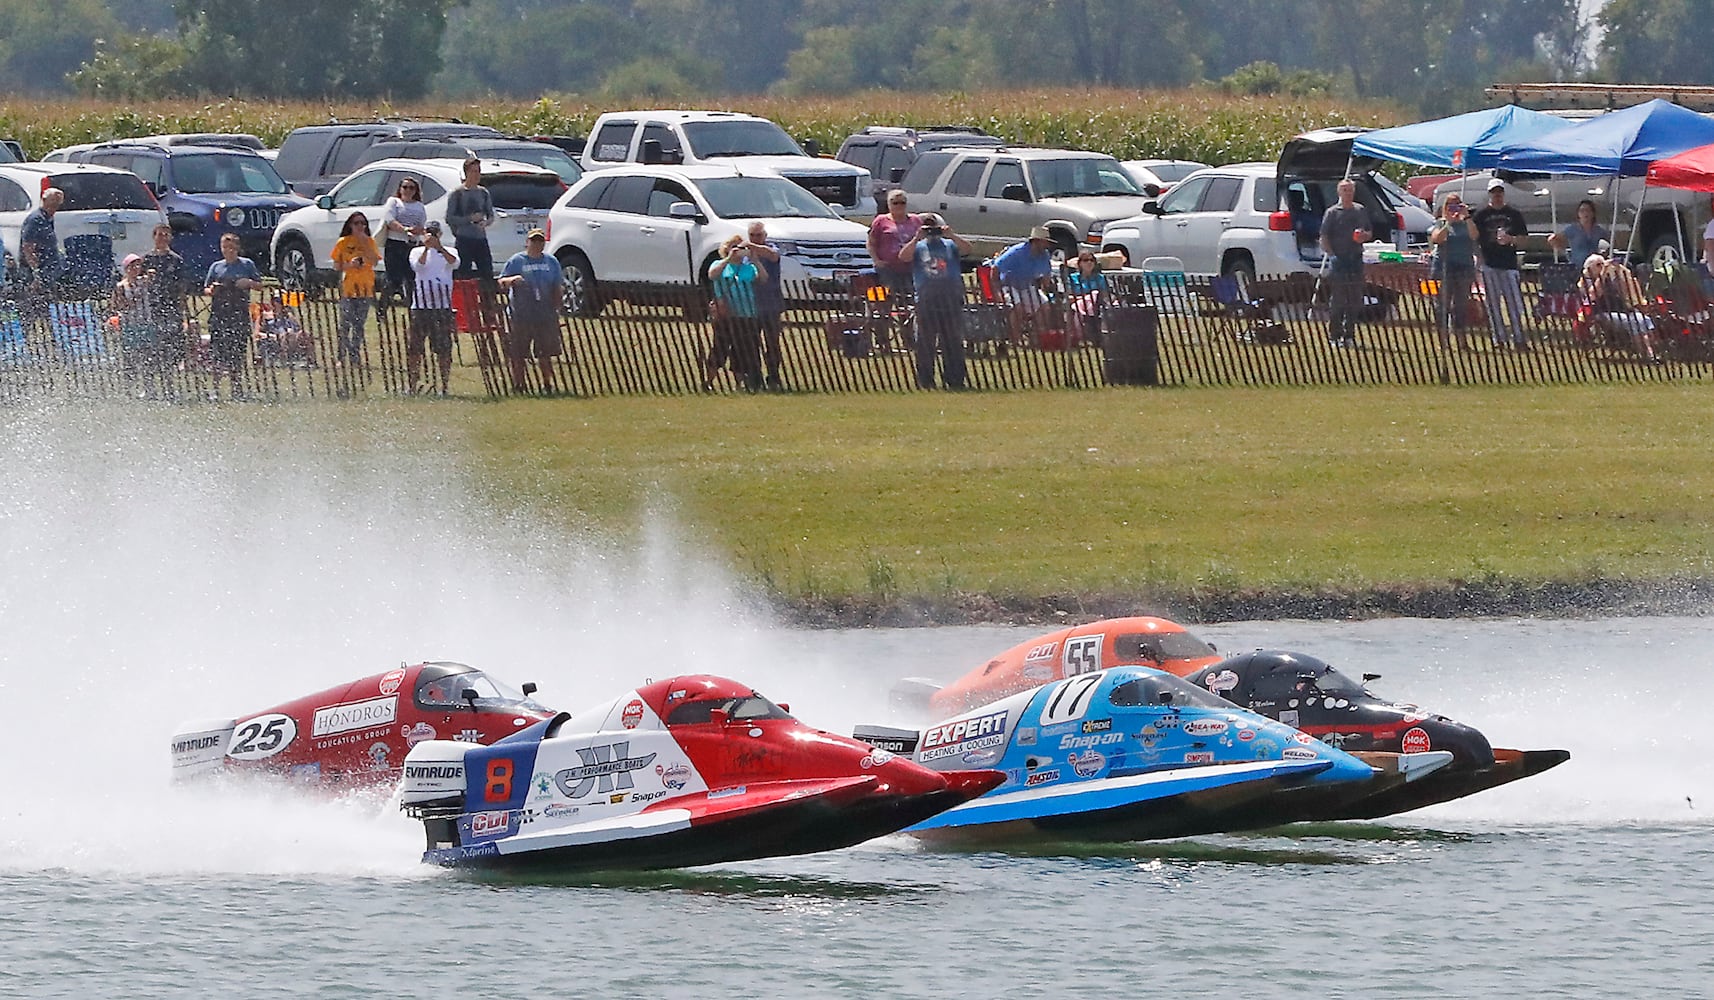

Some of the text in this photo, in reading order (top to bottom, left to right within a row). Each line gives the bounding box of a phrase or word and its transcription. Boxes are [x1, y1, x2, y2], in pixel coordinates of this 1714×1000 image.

[1068, 641, 1096, 677] 55
[1049, 674, 1102, 719] 17
[318, 703, 392, 728] HONDROS
[624, 705, 642, 714] NGK
[231, 718, 287, 754] 25
[318, 728, 391, 749] EDUCATION GROUP
[924, 712, 1007, 747] EXPERT
[863, 739, 903, 751] hnson
[923, 746, 955, 760] HEATING
[967, 736, 1000, 750] COOLING
[1059, 732, 1124, 750] Snap-on
[1407, 736, 1425, 744] NGK
[406, 767, 463, 778] EVINRUDE
[580, 762, 621, 776] PERFORMANCE
[624, 760, 643, 769] BOATS
[485, 759, 513, 803] 8
[1026, 770, 1060, 785] AMSOIL
[632, 791, 666, 803] Snap-on
[473, 812, 508, 831] CDI
[461, 847, 495, 858] Marine
